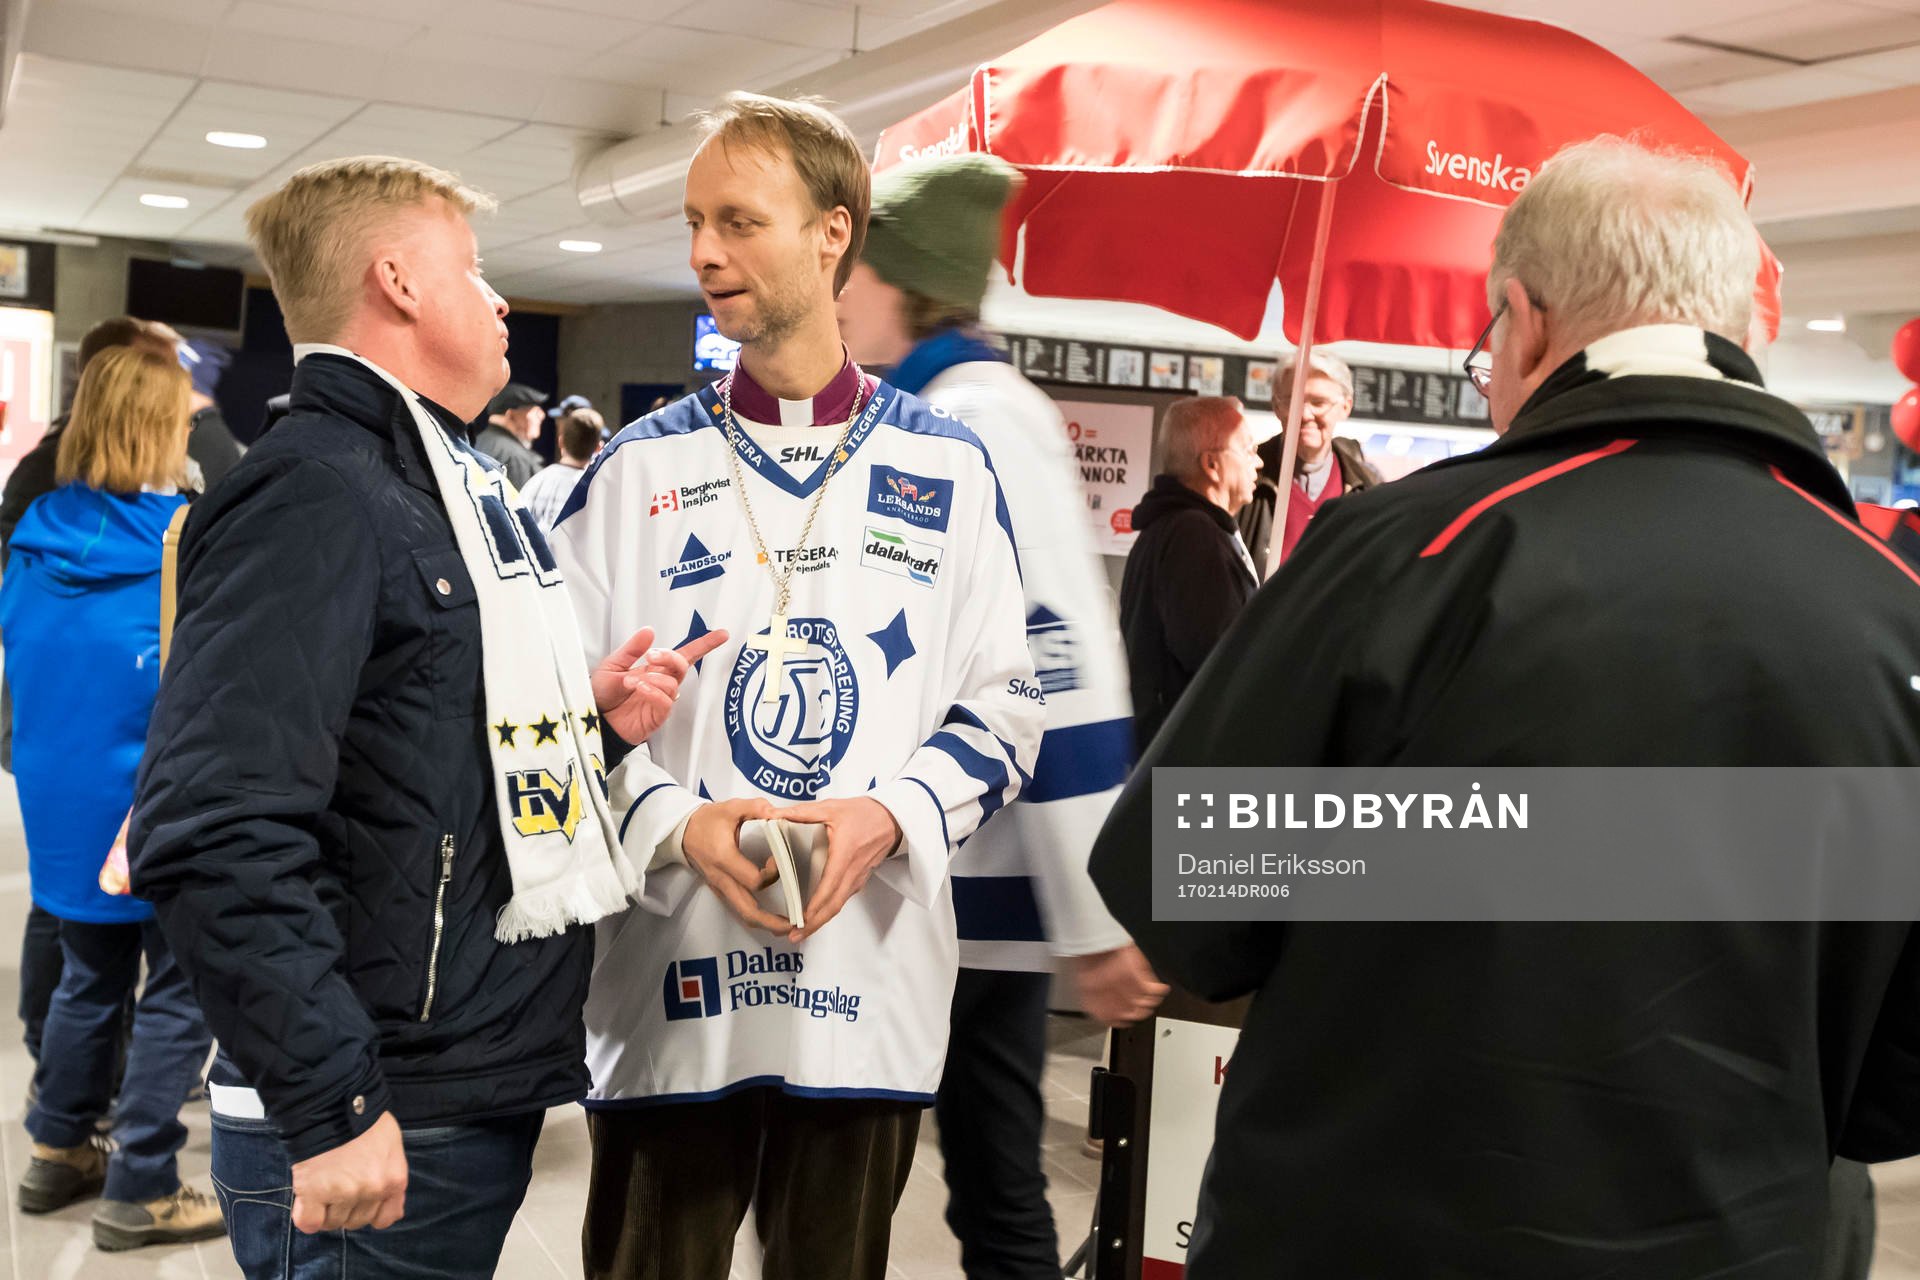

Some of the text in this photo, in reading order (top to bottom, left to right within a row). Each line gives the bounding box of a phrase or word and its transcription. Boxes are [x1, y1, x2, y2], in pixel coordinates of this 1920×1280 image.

[1425, 140, 1531, 192] Svenska
[846, 395, 886, 450] TEGERA
[779, 445, 825, 464] SHL
[1075, 443, 1128, 465] ÄRKTA
[680, 478, 731, 497] Bergkvist
[682, 493, 718, 510] Insjön
[877, 493, 941, 518] LEKSANDS
[660, 550, 732, 578] ERLANDSSON
[774, 546, 838, 563] TEGERA
[865, 541, 939, 575] dalakraft
